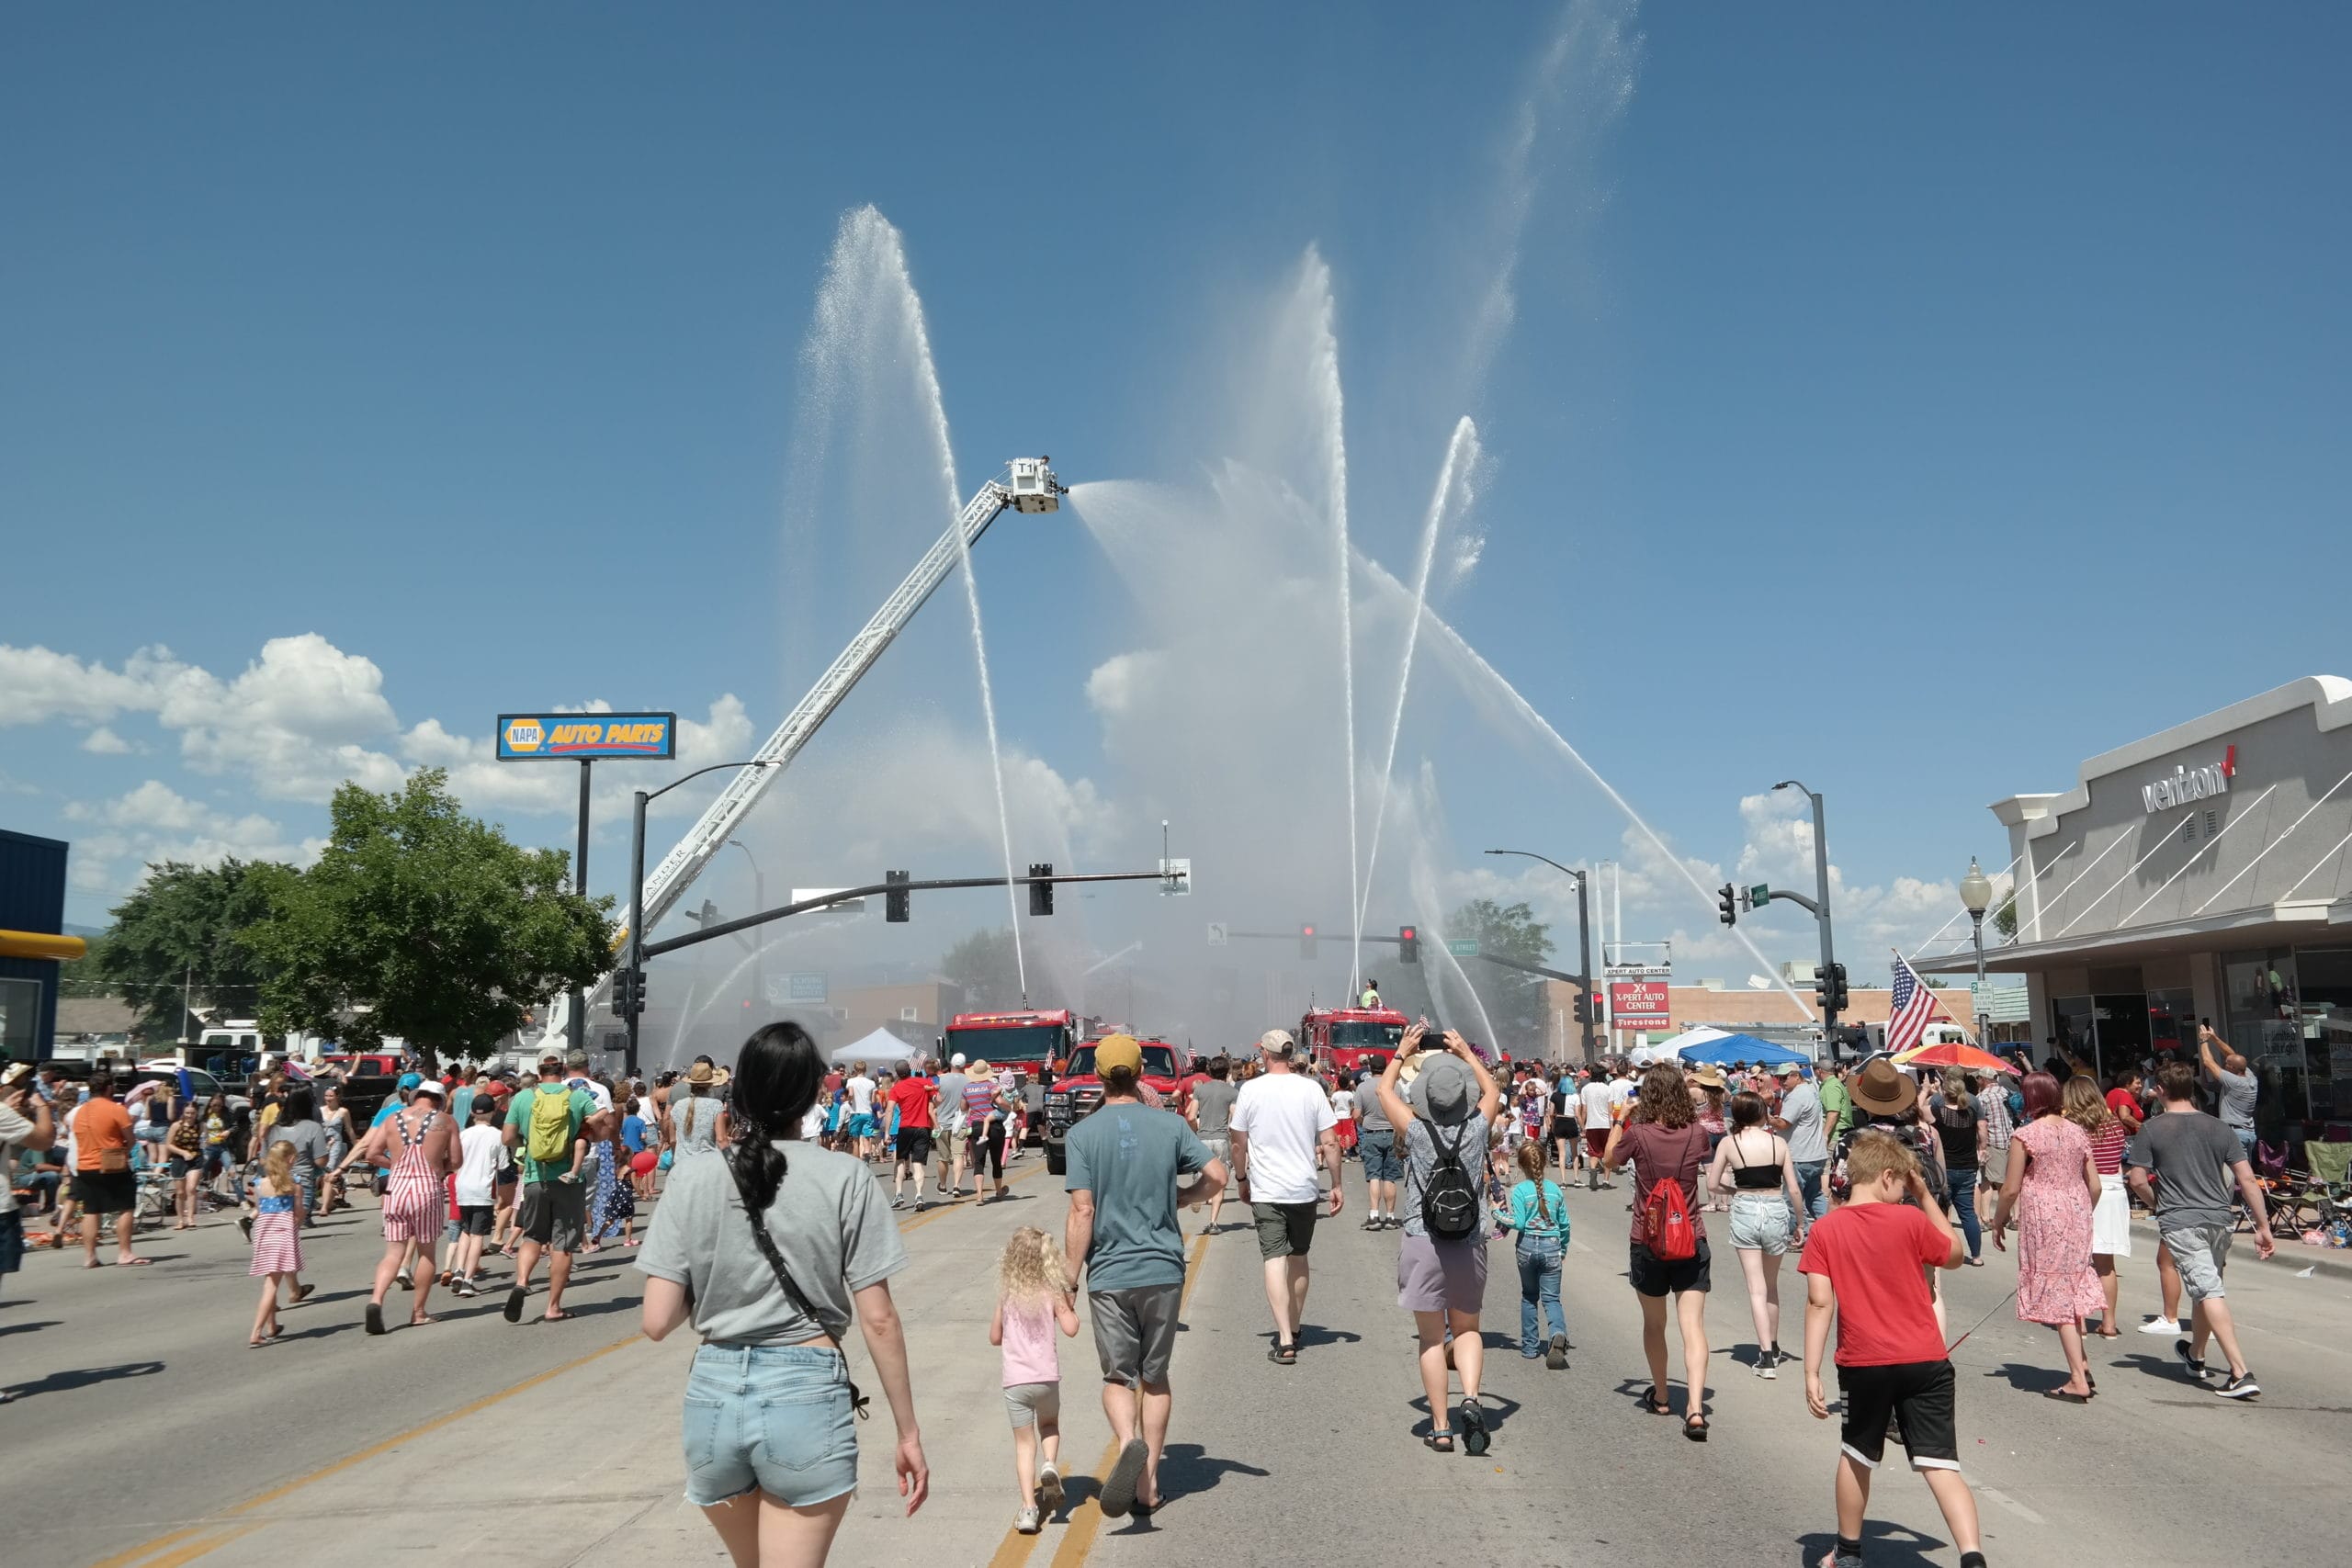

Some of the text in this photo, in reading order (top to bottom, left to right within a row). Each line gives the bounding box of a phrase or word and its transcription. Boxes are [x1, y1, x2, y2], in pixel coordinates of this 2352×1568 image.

[512, 728, 538, 742] NAPA
[548, 724, 665, 744] AUTO PARTS
[2142, 762, 2228, 813] verizon
[1972, 983, 1977, 992] 2
[1644, 993, 1665, 1001] AUTO
[1626, 1001, 1656, 1010] CENTER
[1617, 1019, 1668, 1027] Firestone
